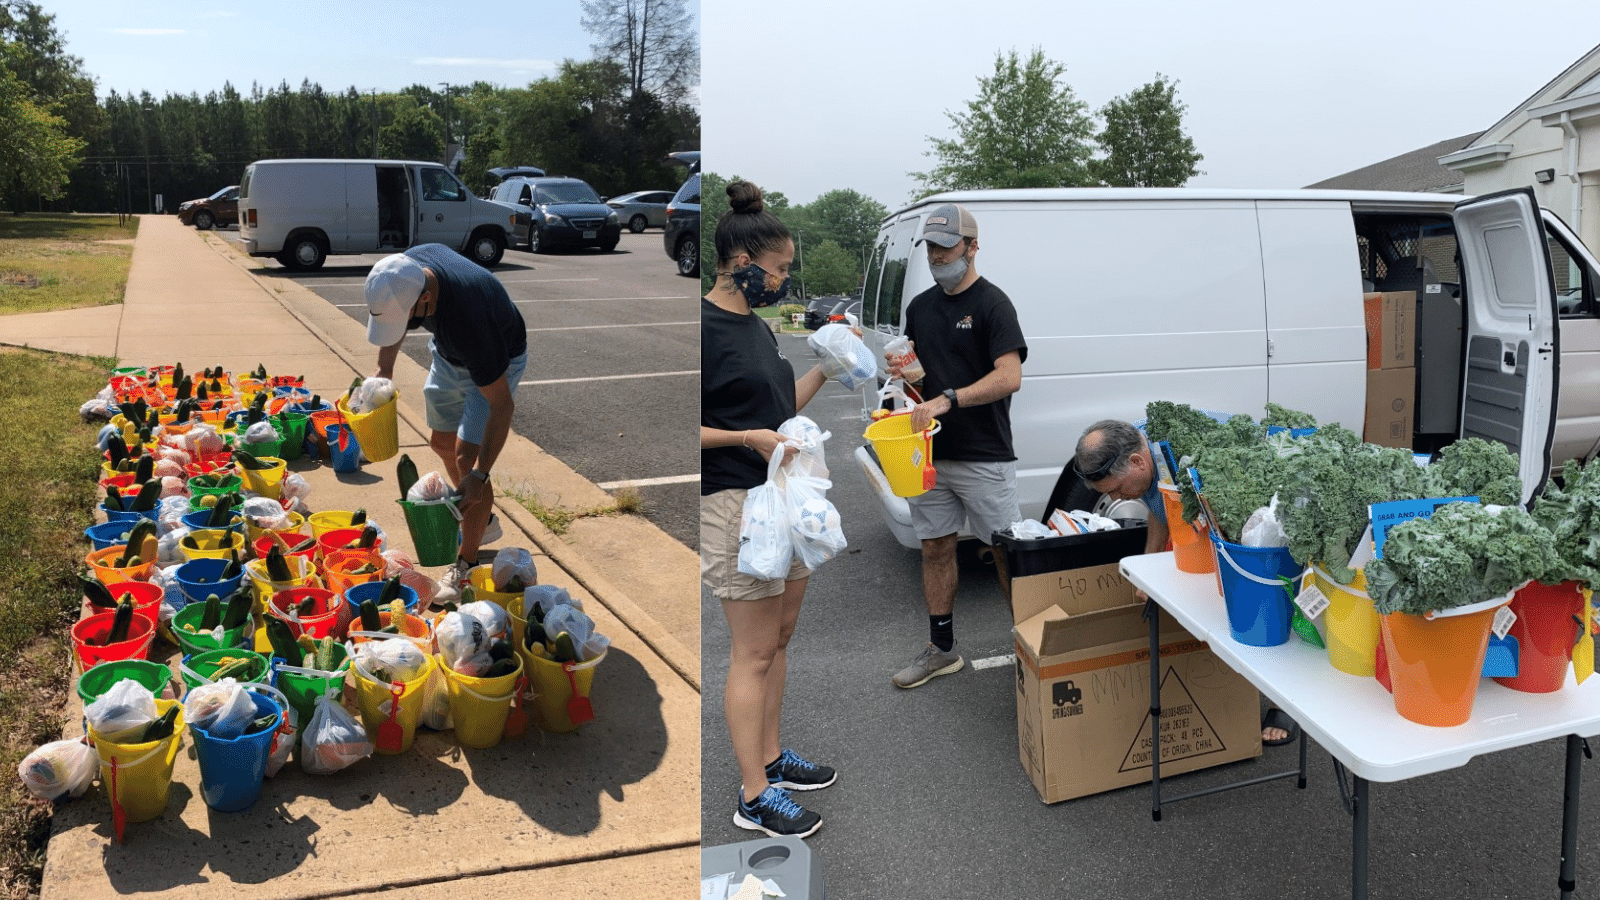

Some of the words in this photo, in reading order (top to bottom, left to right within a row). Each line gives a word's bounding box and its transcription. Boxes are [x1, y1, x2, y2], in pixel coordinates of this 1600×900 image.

[1377, 513, 1396, 522] GRAB
[1398, 511, 1415, 519] AND
[1418, 510, 1431, 518] GO
[1058, 576, 1087, 600] 40
[1135, 646, 1171, 660] SPNG
[1176, 640, 1202, 652] TOYS
[1141, 737, 1153, 749] CAS
[1192, 727, 1204, 739] PCS
[1132, 750, 1153, 764] COUNT
[1195, 738, 1213, 751] CHINA
